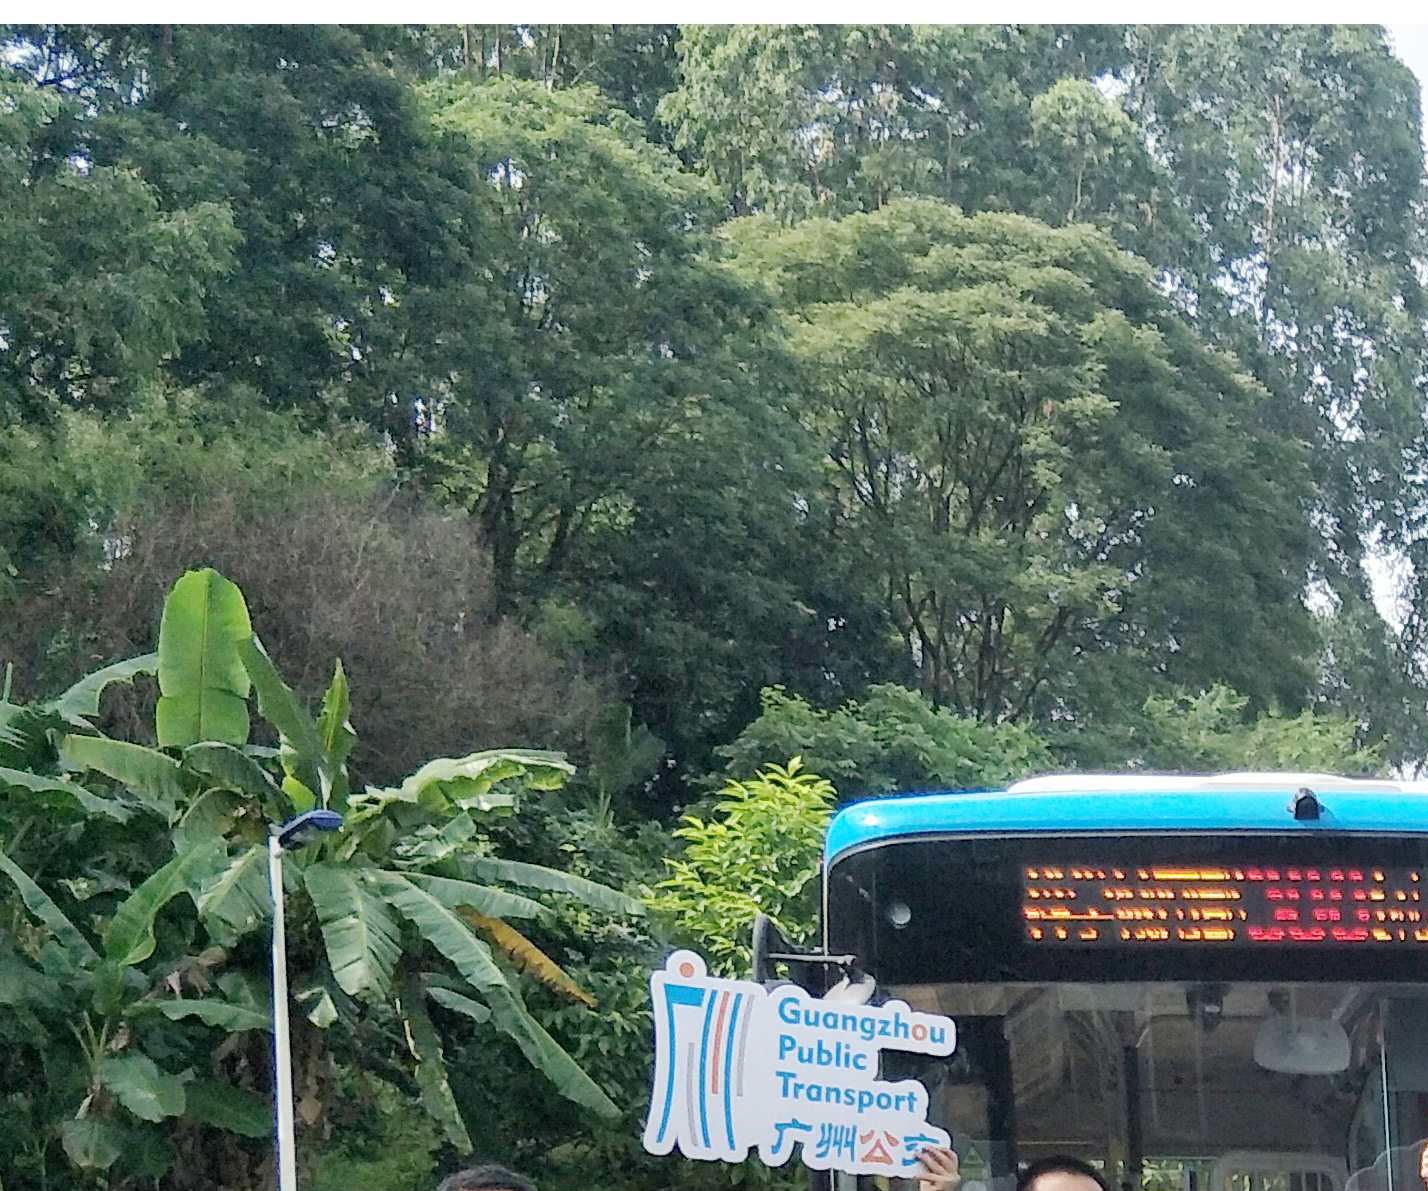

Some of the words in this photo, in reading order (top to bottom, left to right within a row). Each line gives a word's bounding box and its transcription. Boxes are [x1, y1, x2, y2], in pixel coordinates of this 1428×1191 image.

[778, 997, 946, 1044] Guangzhou
[778, 1034, 867, 1071] Public
[775, 1071, 918, 1114] Transport
